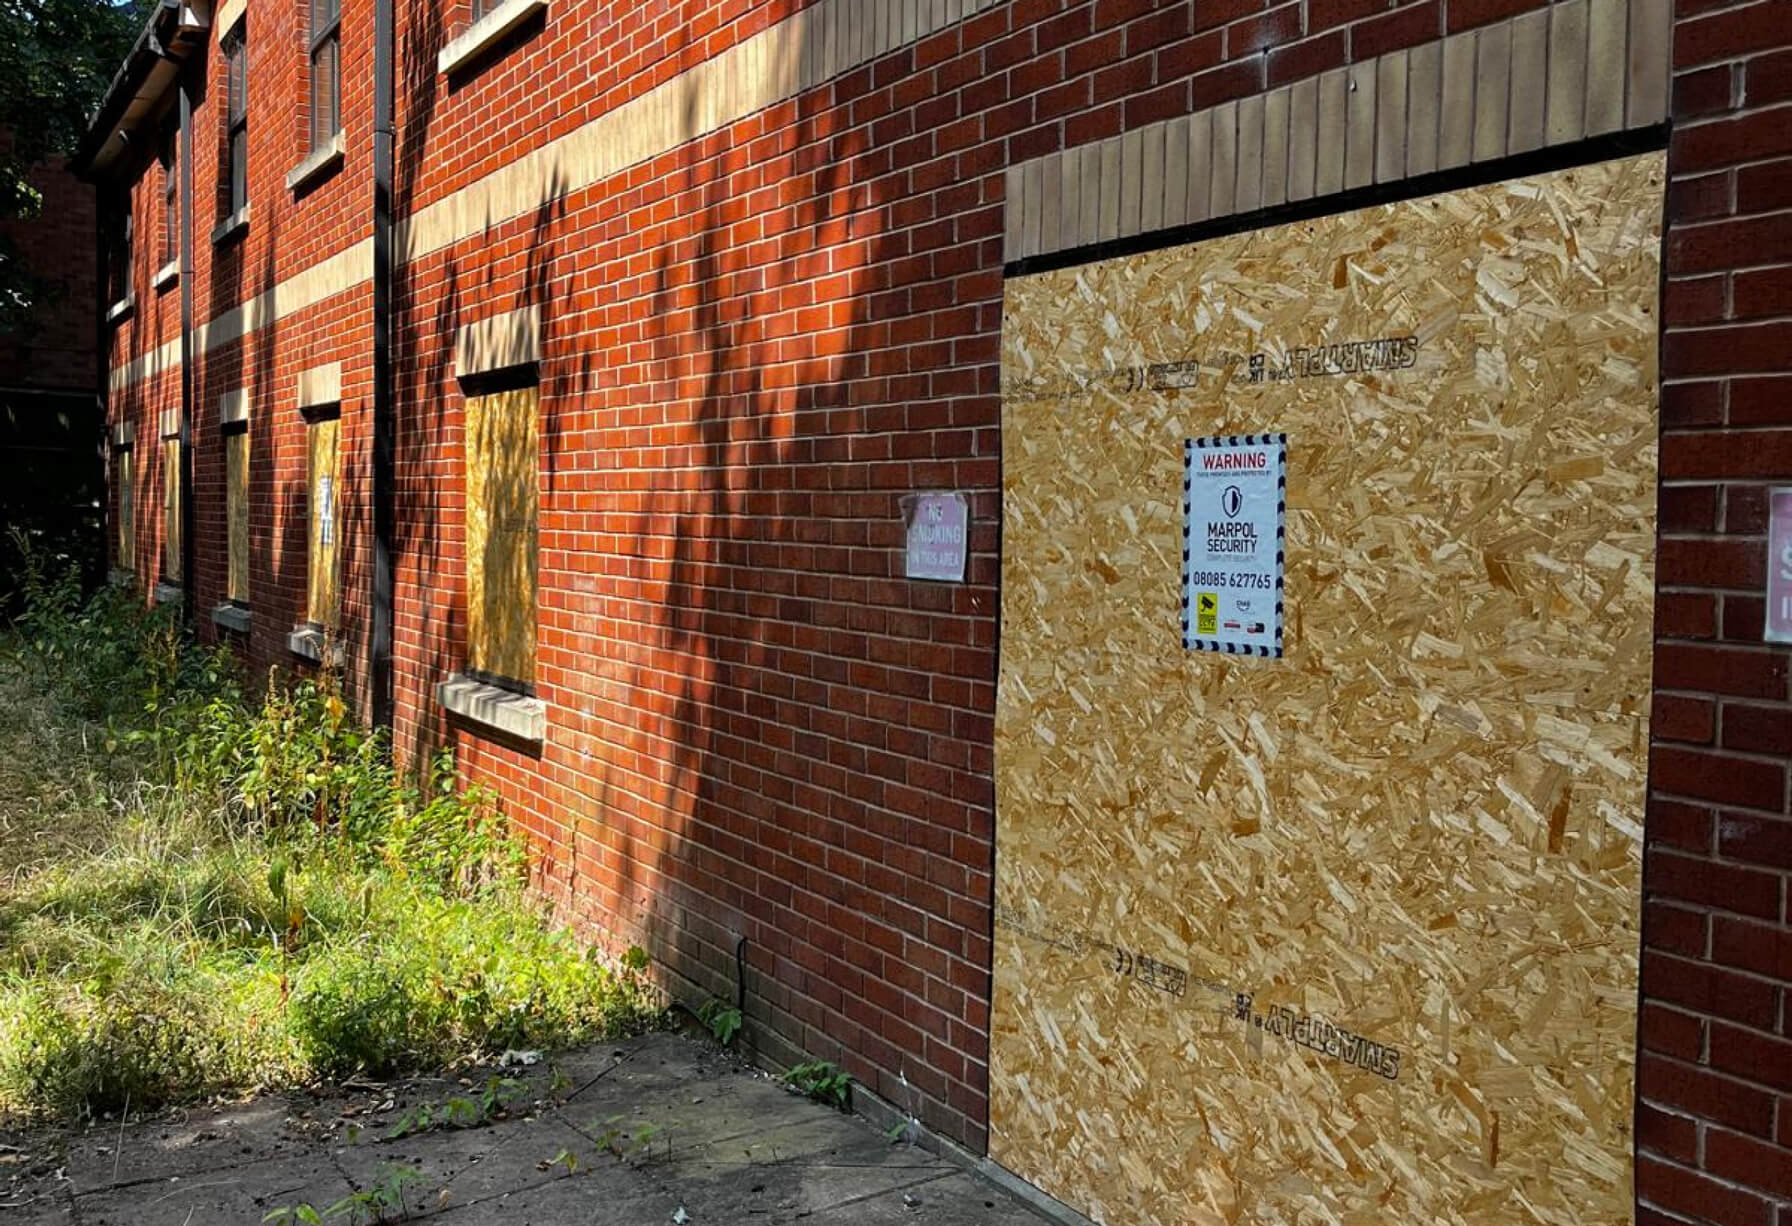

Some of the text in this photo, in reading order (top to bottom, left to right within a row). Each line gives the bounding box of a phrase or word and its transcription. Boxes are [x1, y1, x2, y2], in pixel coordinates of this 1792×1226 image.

[1283, 336, 1418, 378] SMARTPLY
[1203, 452, 1266, 470] WARNING
[928, 503, 943, 520] NO
[912, 524, 961, 545] SMOKING
[1207, 521, 1258, 538] MARPOL
[1207, 538, 1257, 553] SECURITY
[1193, 571, 1271, 589] 08085 627765
[1265, 1004, 1399, 1079] SMARTPLY
